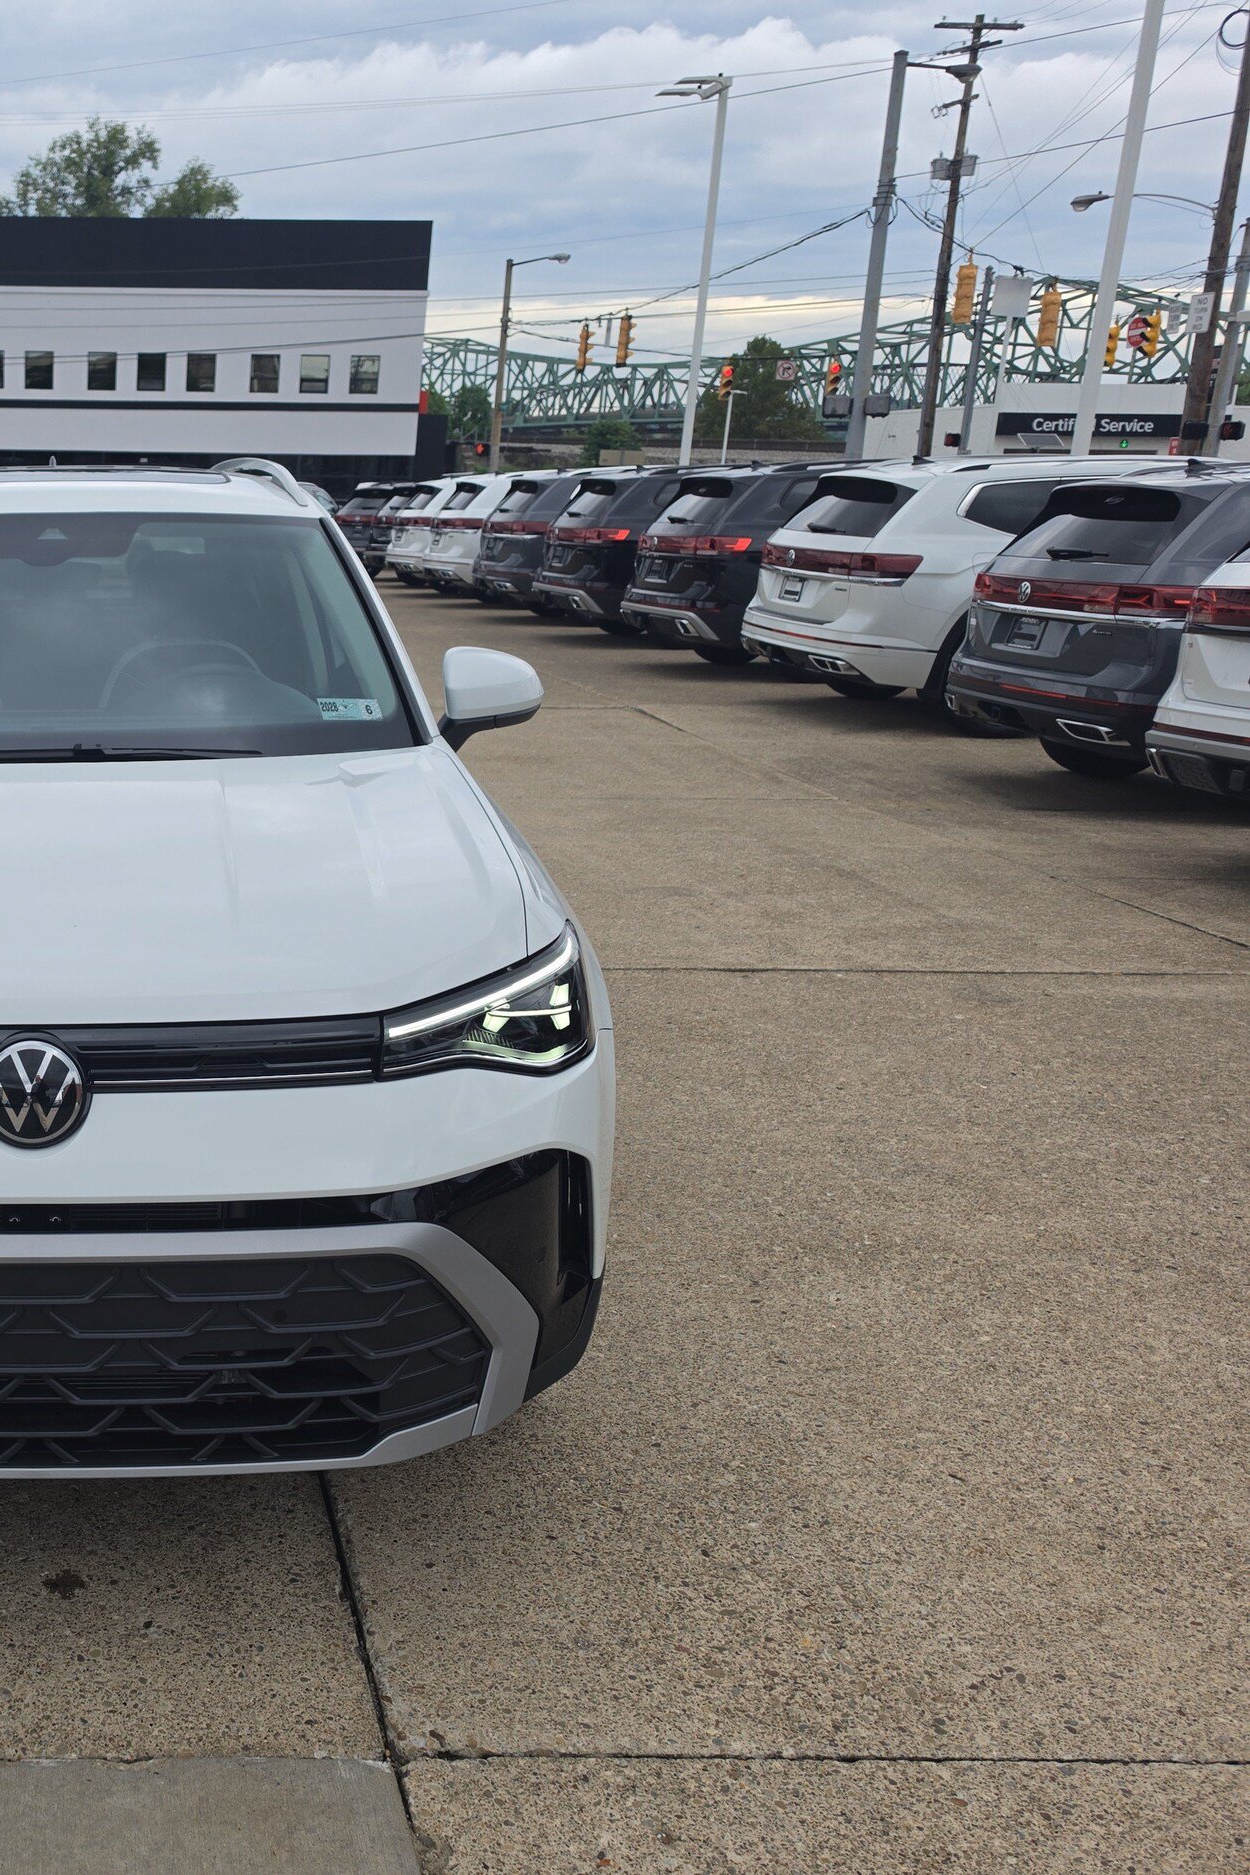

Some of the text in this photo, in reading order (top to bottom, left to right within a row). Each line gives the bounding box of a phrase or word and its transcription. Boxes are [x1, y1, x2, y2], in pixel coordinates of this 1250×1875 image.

[1032, 416, 1154, 433] Certif Service
[365, 704, 373, 715] 6
